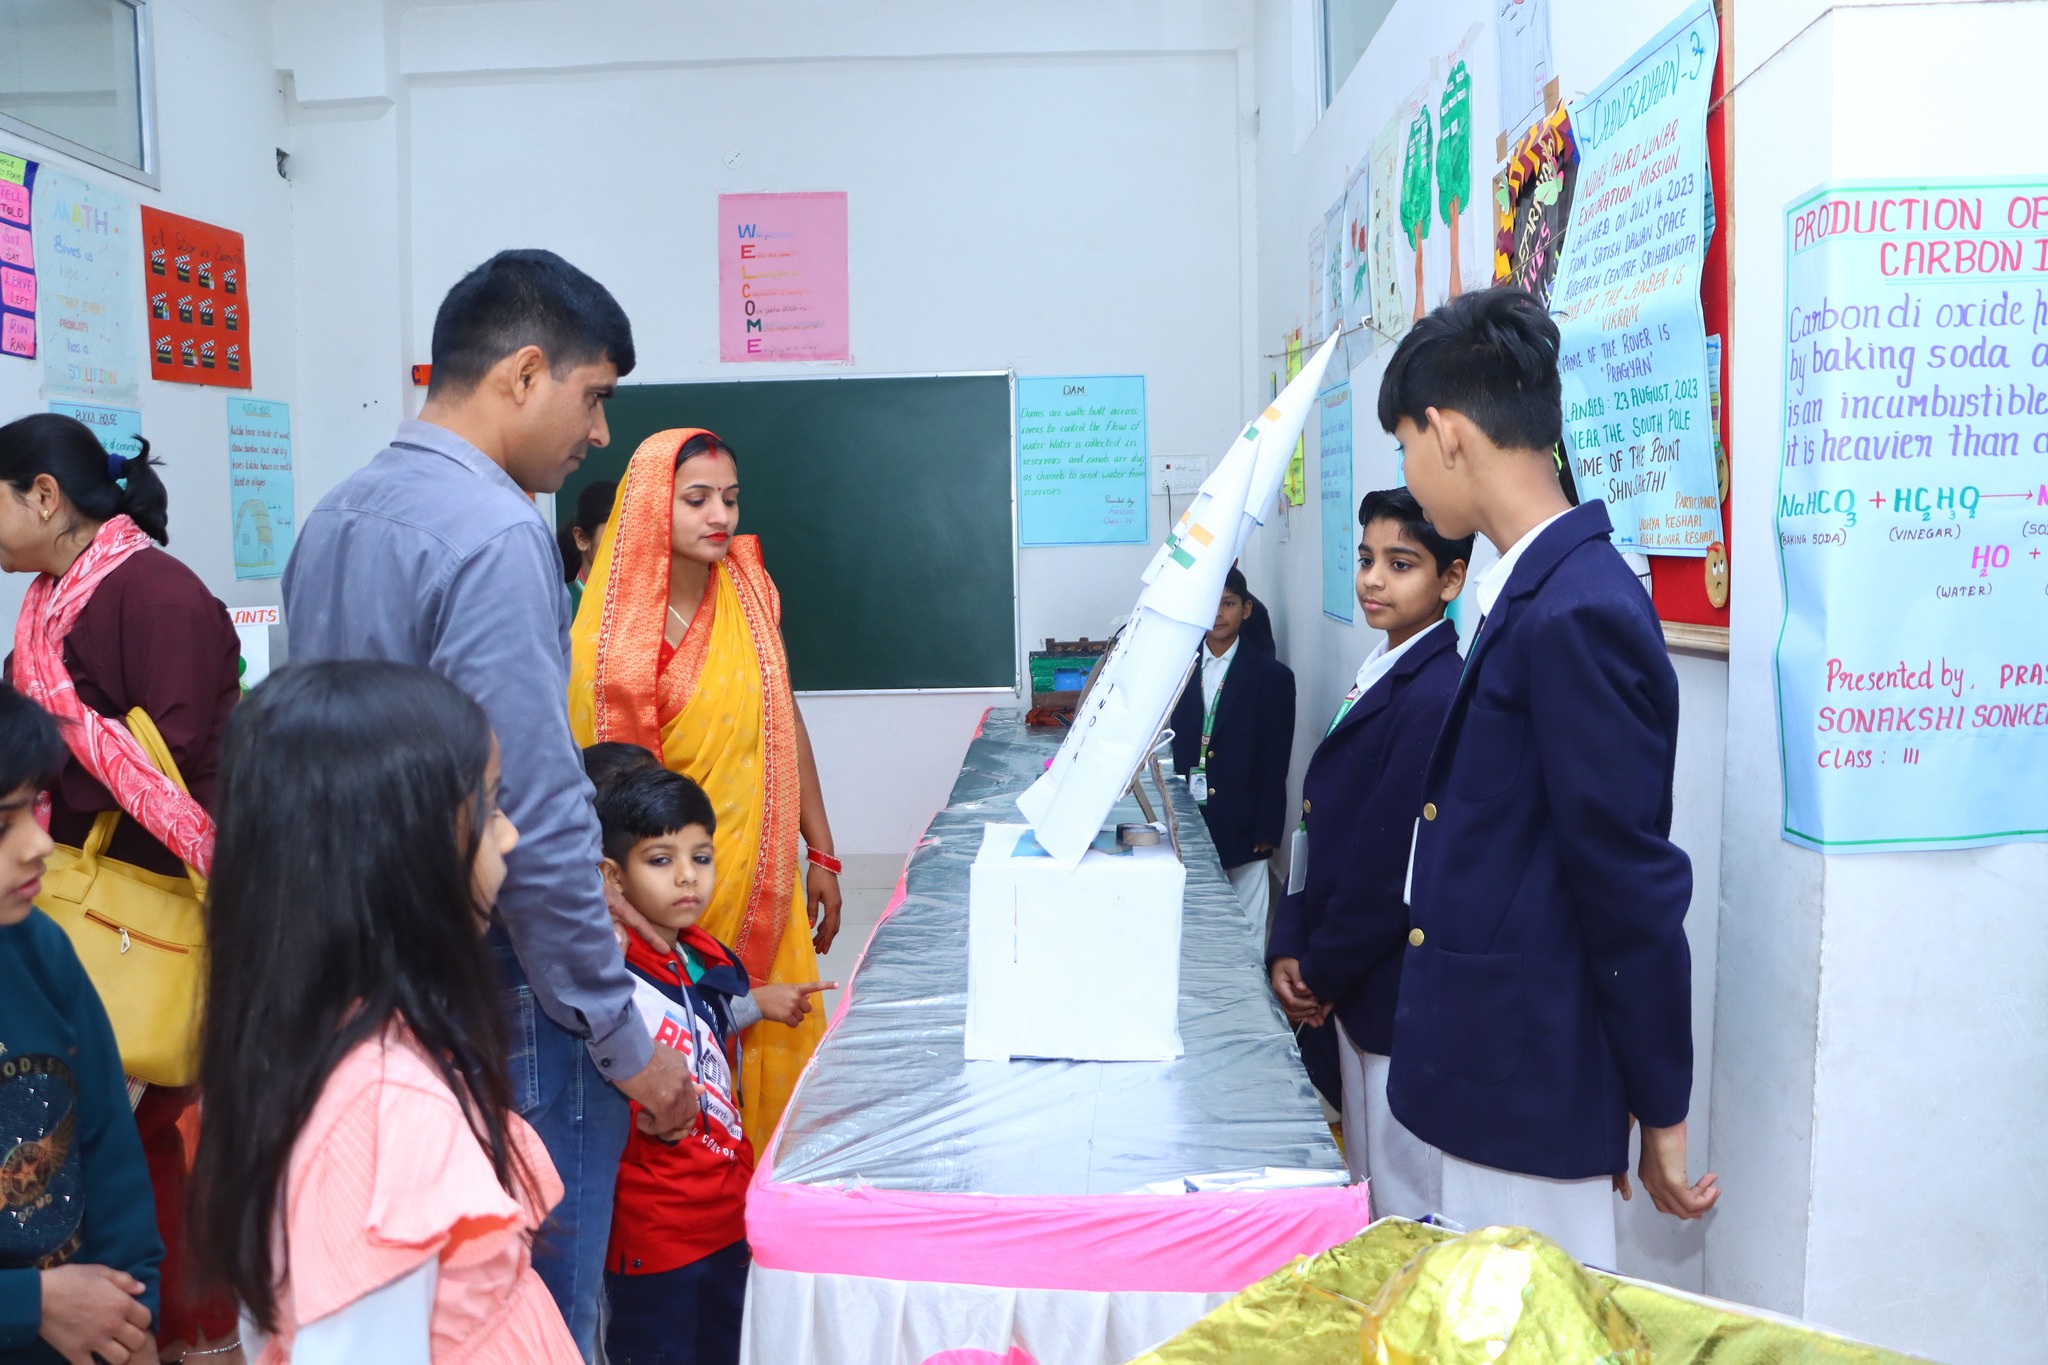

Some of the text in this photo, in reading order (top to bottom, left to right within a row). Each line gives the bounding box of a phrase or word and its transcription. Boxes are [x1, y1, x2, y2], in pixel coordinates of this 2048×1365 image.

[1609, 143, 1641, 177] THIRD
[1641, 118, 1679, 161] LUNAR
[1636, 145, 1681, 191] MISSION
[0, 184, 23, 204] TELL
[1615, 210, 1628, 232] ON
[1629, 193, 1651, 223] JULY
[1653, 188, 1663, 210] 14
[1667, 172, 1694, 202] 2023
[0, 202, 24, 218] TOLD
[52, 199, 109, 237] MATH
[1656, 207, 1687, 240] SPACE
[1794, 197, 1982, 252] PRODUCTION
[3, 227, 20, 246] SIT
[1879, 239, 2023, 276] CARBON
[4, 270, 32, 293] LEAVE
[1583, 293, 1600, 315] OF
[1600, 285, 1625, 310] THE
[1672, 263, 1686, 286] IS
[11, 291, 29, 308] LEFT
[1935, 290, 2025, 329] oxide
[9, 318, 28, 335] RUN
[9, 337, 26, 352] RAN
[1587, 345, 1597, 364] OF
[1601, 339, 1618, 360] THE
[1621, 327, 1653, 355] ROVER
[1657, 323, 1671, 341] IS
[68, 363, 118, 385] SOLUTION
[1789, 348, 1807, 396] by
[1813, 336, 1916, 388] baking
[1926, 335, 2010, 369] soda
[1063, 385, 1085, 395] DAM
[1614, 391, 1630, 411] 23
[1674, 377, 1699, 400] 2023
[100, 413, 118, 426] HOUSE
[1021, 407, 1044, 418] Dams
[1049, 410, 1061, 418] are
[1111, 408, 1138, 416] across
[1021, 420, 1142, 435] rivers to control the flow of
[1602, 423, 1626, 442] THE
[1632, 413, 1664, 438] SOUTH
[1667, 409, 1691, 432] POLE
[1023, 440, 1045, 450] water
[1075, 439, 1081, 449] is
[1085, 437, 1121, 448] collected
[1125, 438, 1137, 447] in
[1785, 435, 1799, 467] it
[1803, 435, 1815, 466] is
[1821, 429, 1933, 462] heavier
[1949, 424, 2019, 457] than
[1068, 454, 1084, 464] and
[1113, 456, 1127, 464] are
[1131, 453, 1145, 467] dug
[1577, 436, 1681, 478] AME OF THE POINT
[1069, 469, 1077, 480] to
[1080, 469, 1099, 480] send
[1102, 470, 1127, 480] water
[1128, 469, 1146, 479] from
[1665, 513, 1702, 529] KESHARI
[1684, 529, 1716, 545] KESHARI
[1812, 527, 1847, 546] SODA)
[1889, 523, 1962, 542] (VINEGAR)
[1936, 582, 1993, 600] (WATER)
[232, 609, 277, 625] ANTS
[1826, 657, 1934, 692] Presented
[1817, 702, 2048, 734] SONAKSHI SONKE
[1903, 747, 1920, 765] III
[707, 1101, 729, 1124] wards
